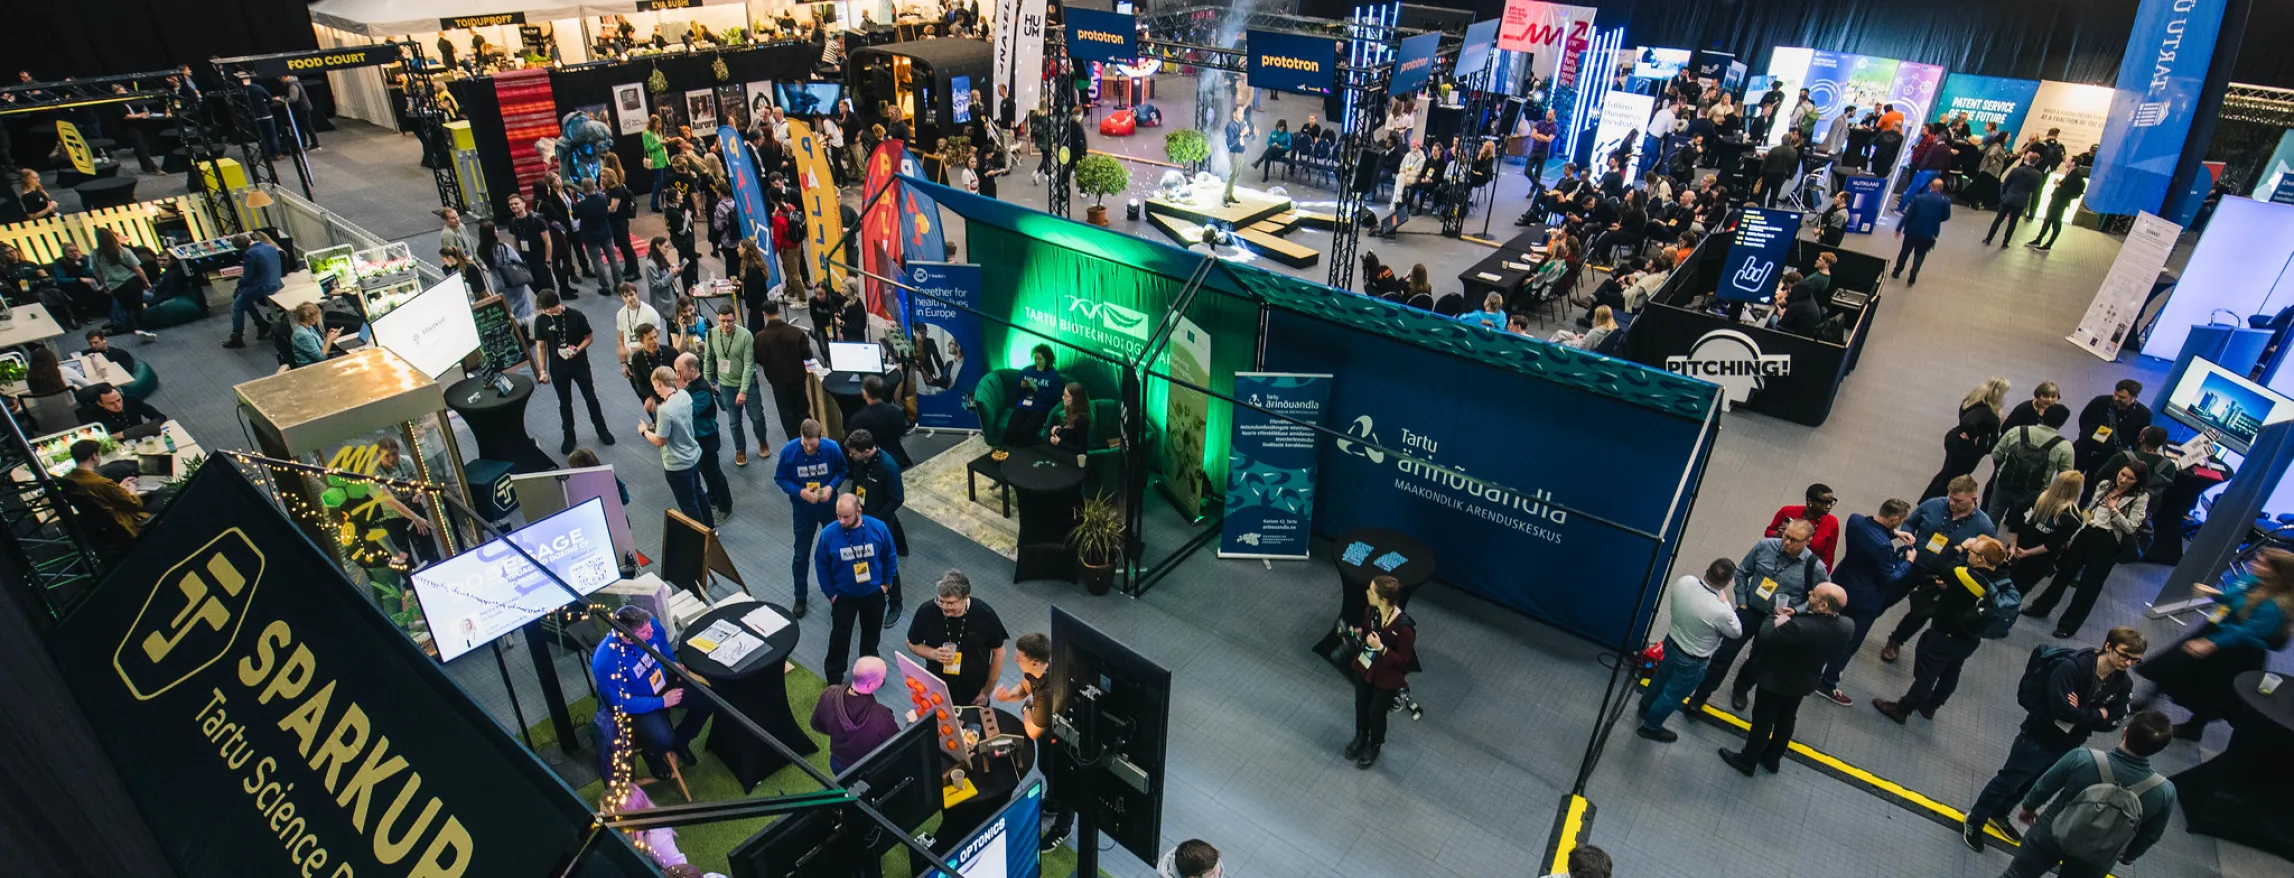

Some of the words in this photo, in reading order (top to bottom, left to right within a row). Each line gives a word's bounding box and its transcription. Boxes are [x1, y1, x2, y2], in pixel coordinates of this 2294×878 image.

[651, 1, 667, 9] EVA
[1024, 14, 1041, 27] HU
[1023, 26, 1040, 38] UM
[1077, 28, 1124, 45] prototron
[287, 58, 323, 71] FOOD
[325, 52, 366, 67] COURT
[1261, 53, 1319, 73] prototron
[1400, 57, 1429, 74] prototron
[1952, 96, 1983, 110] PATENT
[1982, 99, 2016, 113] SERVICE
[692, 120, 717, 130] Aurora
[1976, 111, 2007, 124] FUTURE
[915, 286, 953, 298] Together
[955, 287, 967, 298] for
[916, 308, 924, 316] in
[925, 310, 956, 320] Europe
[1025, 306, 1057, 327] TARTU
[1667, 360, 1789, 376] PITCHING!
[1265, 400, 1319, 409] ärinõuandla
[1401, 428, 1438, 453] Tartu
[1394, 478, 1463, 511] MAAKONDLIK
[1465, 505, 1563, 545] ARENDUSKESKUS
[238, 620, 473, 878] SPARKUP
[195, 687, 254, 770] Tartu
[243, 756, 328, 878] Science
[960, 817, 1006, 863] OPTONICS
